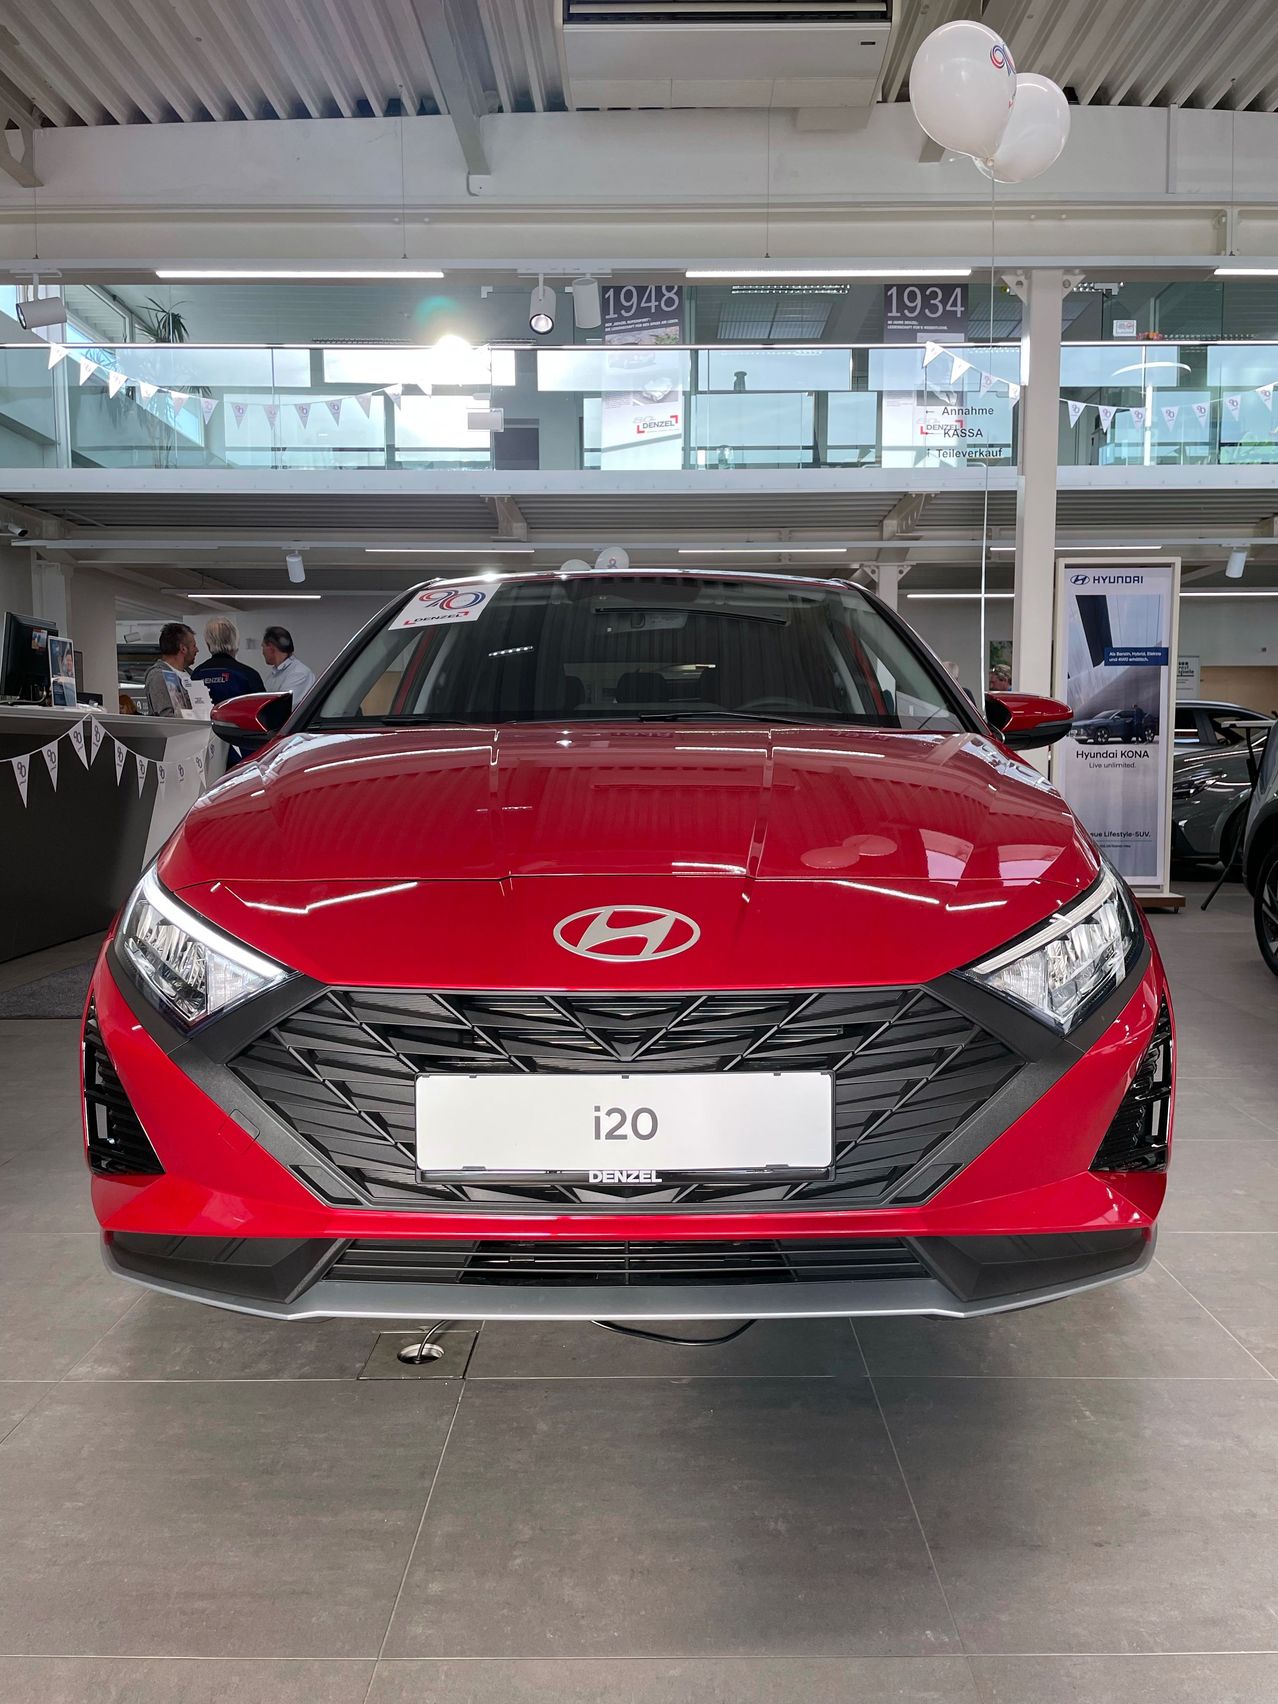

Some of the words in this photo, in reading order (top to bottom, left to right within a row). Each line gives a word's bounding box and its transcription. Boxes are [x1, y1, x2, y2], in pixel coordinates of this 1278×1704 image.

[604, 285, 680, 319] 1948
[887, 286, 965, 318] 1934
[942, 406, 994, 416] Annahme
[642, 420, 675, 429] DENZEL
[943, 428, 984, 438] KASSA
[936, 448, 1003, 458] Teileverkauf
[1093, 575, 1144, 584] HYUNDAI
[419, 589, 487, 611] 90
[414, 613, 463, 623] DENZEL
[204, 676, 226, 684] ENZEL
[1076, 750, 1118, 761] Hyundai
[1120, 750, 1150, 759] KONA
[593, 1105, 659, 1142] i20
[588, 1170, 663, 1183] DENZEL
